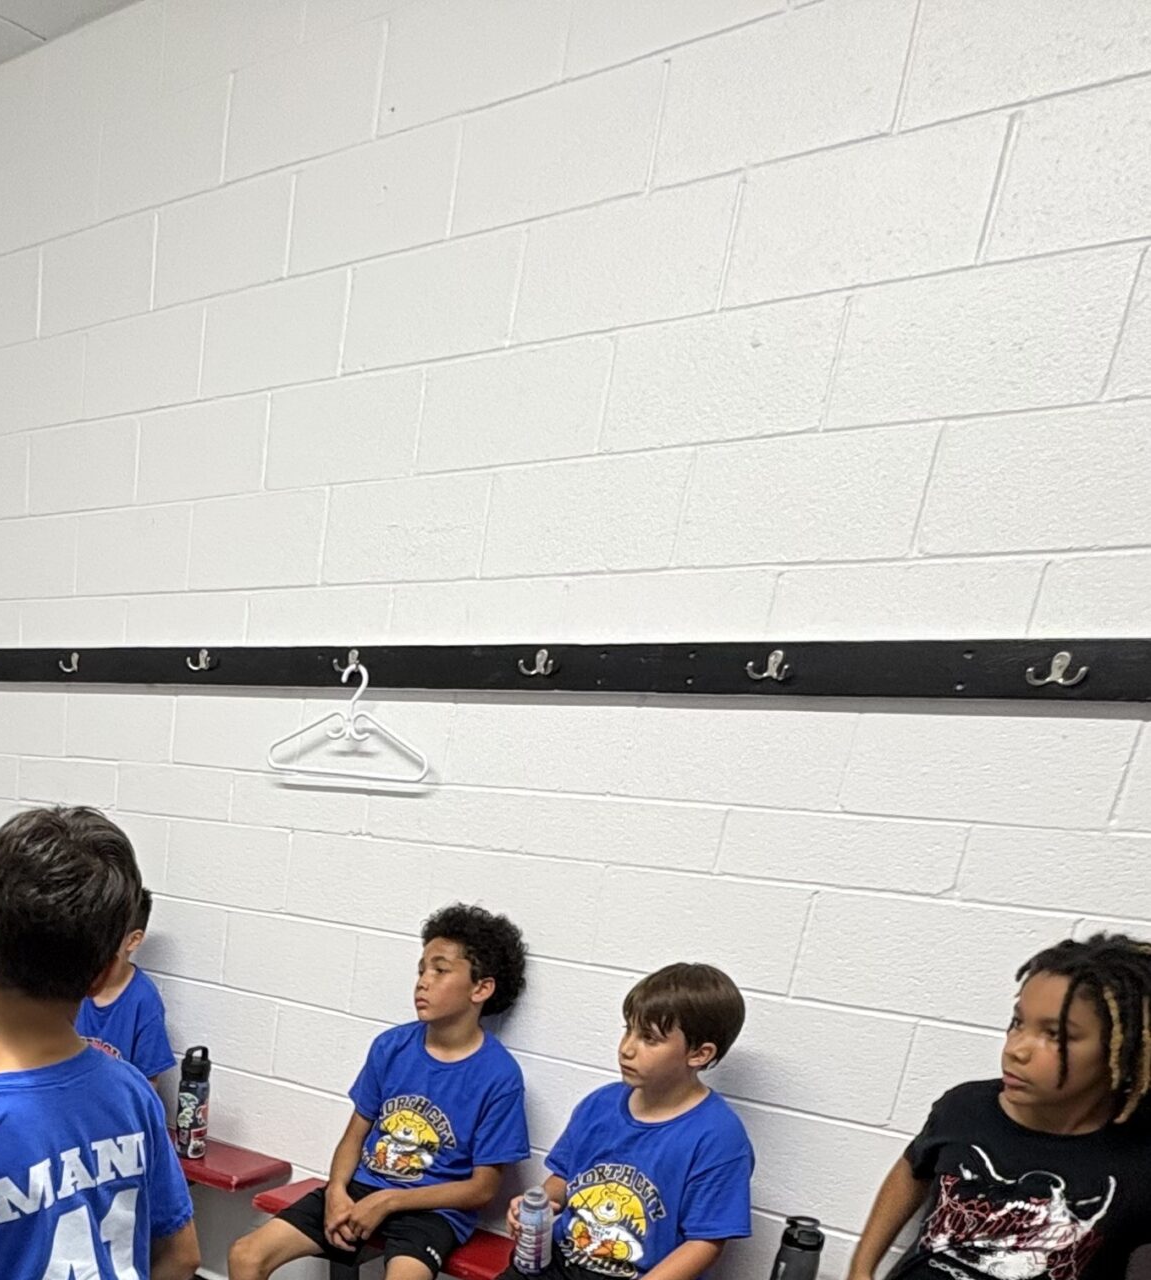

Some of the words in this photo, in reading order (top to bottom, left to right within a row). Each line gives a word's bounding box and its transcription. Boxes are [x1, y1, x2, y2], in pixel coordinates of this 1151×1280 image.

[428, 1105, 457, 1150] CITY
[567, 1163, 636, 1194] NORTH
[633, 1171, 667, 1222] CITY
